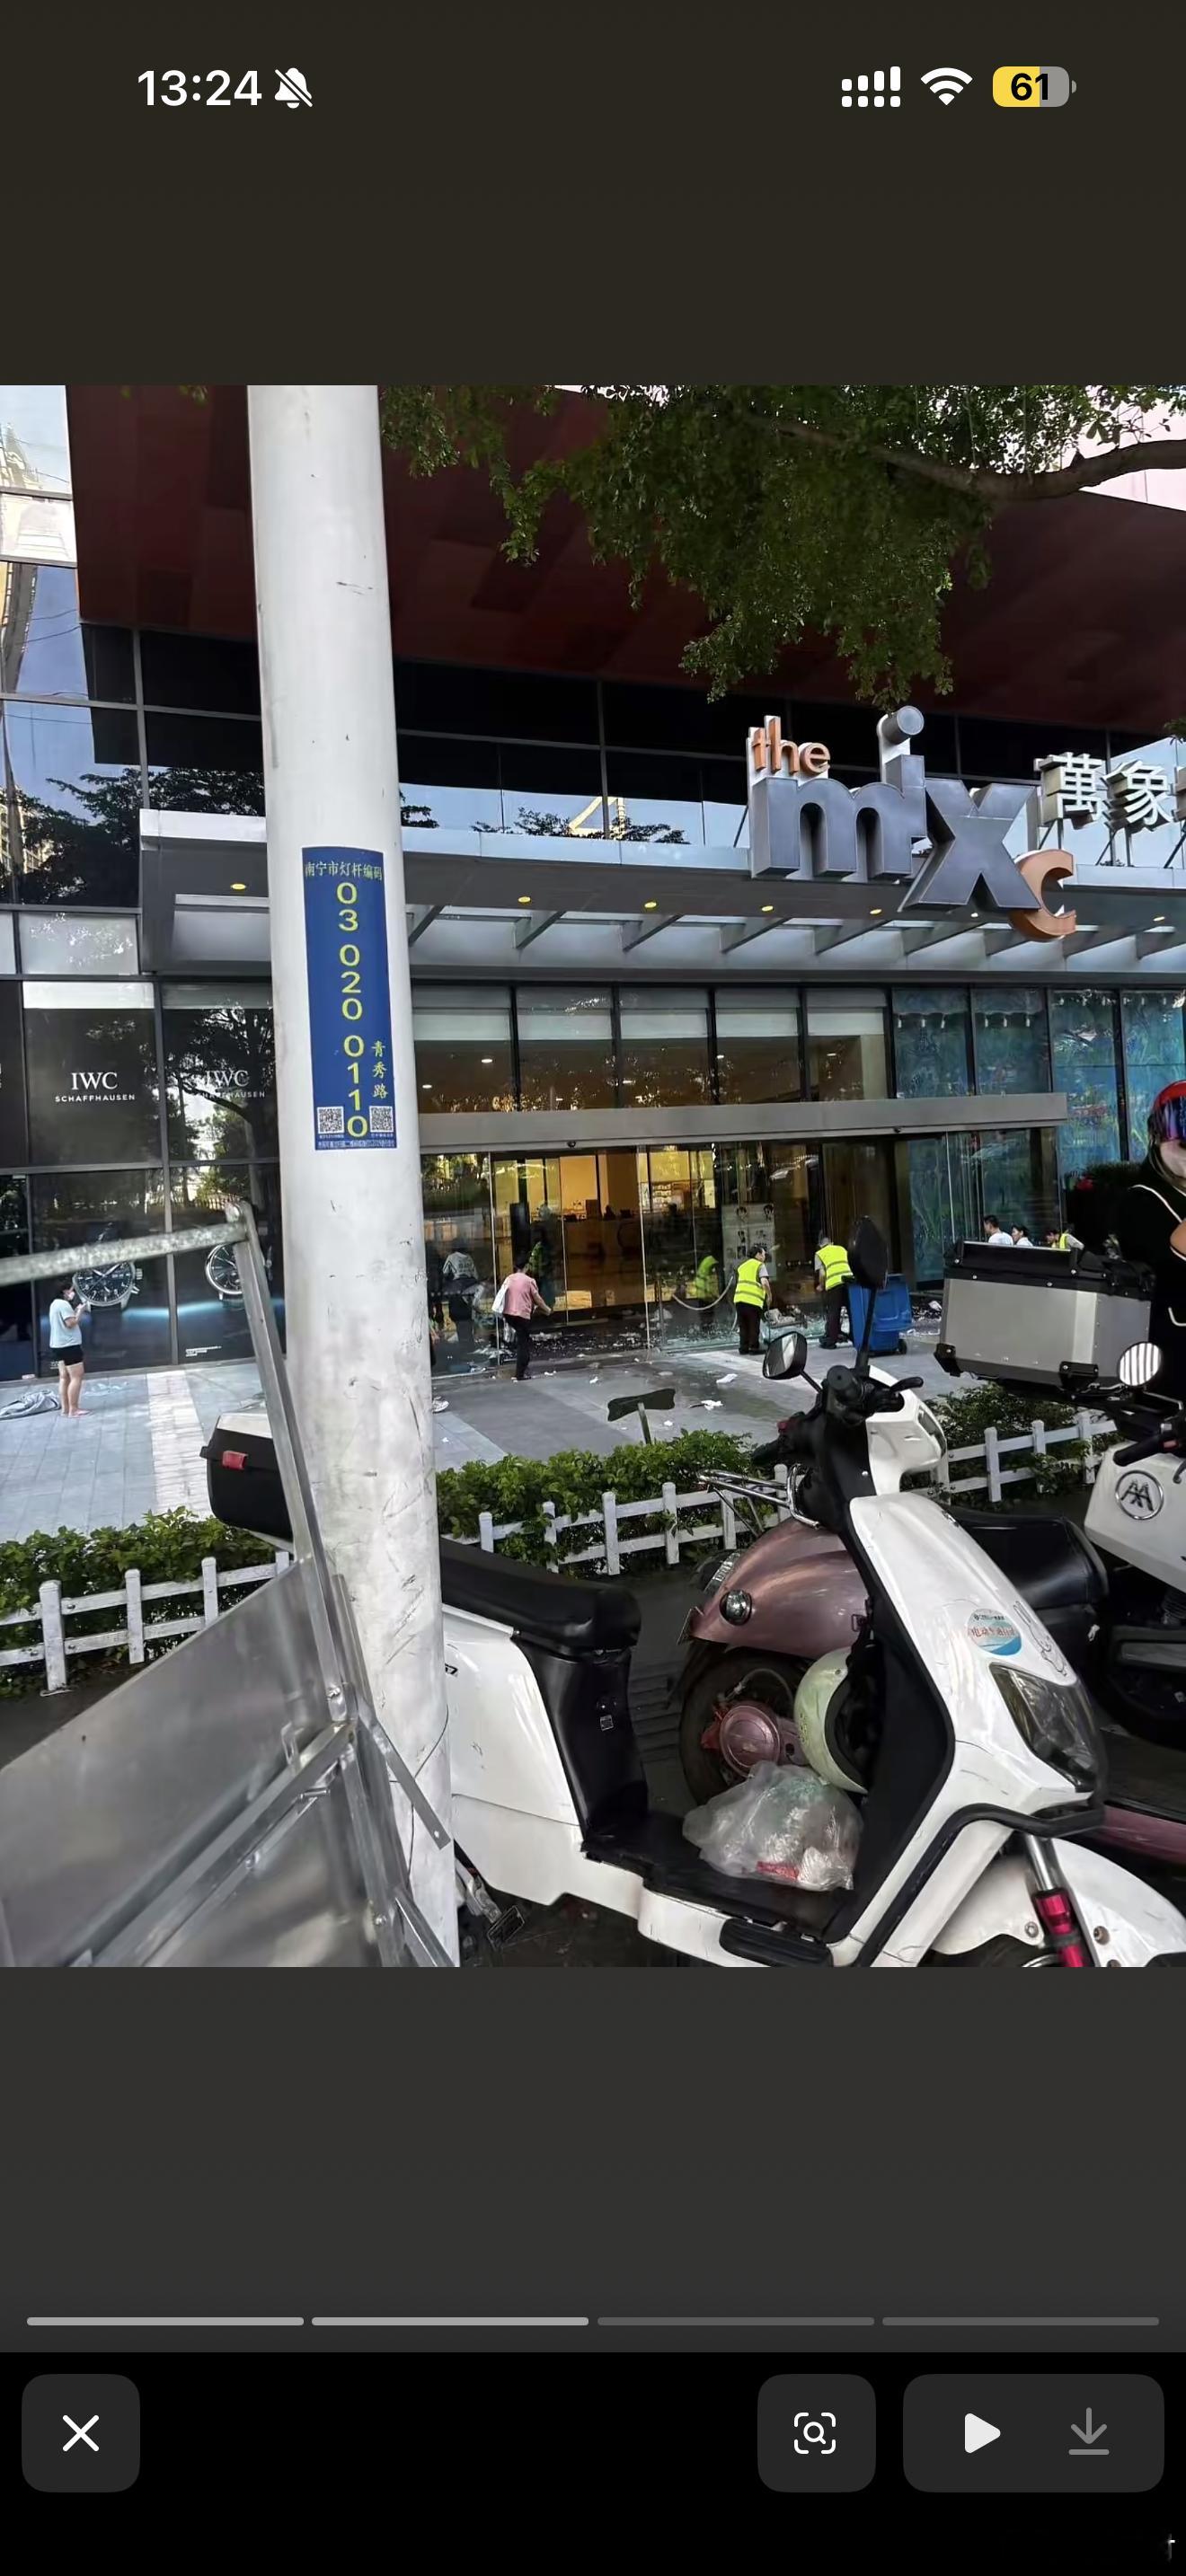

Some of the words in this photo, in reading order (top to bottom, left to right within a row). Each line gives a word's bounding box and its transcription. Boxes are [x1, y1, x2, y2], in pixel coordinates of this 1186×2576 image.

[748, 716, 830, 776] the
[1035, 752, 1186, 832] 萬象
[305, 860, 383, 881] 南宁市灯杆编码
[205, 1070, 250, 1087] IWC
[371, 1040, 388, 1099] 青秀路
[71, 1072, 118, 1090] IWC
[55, 1094, 135, 1103] SCHAFFHAUSEN
